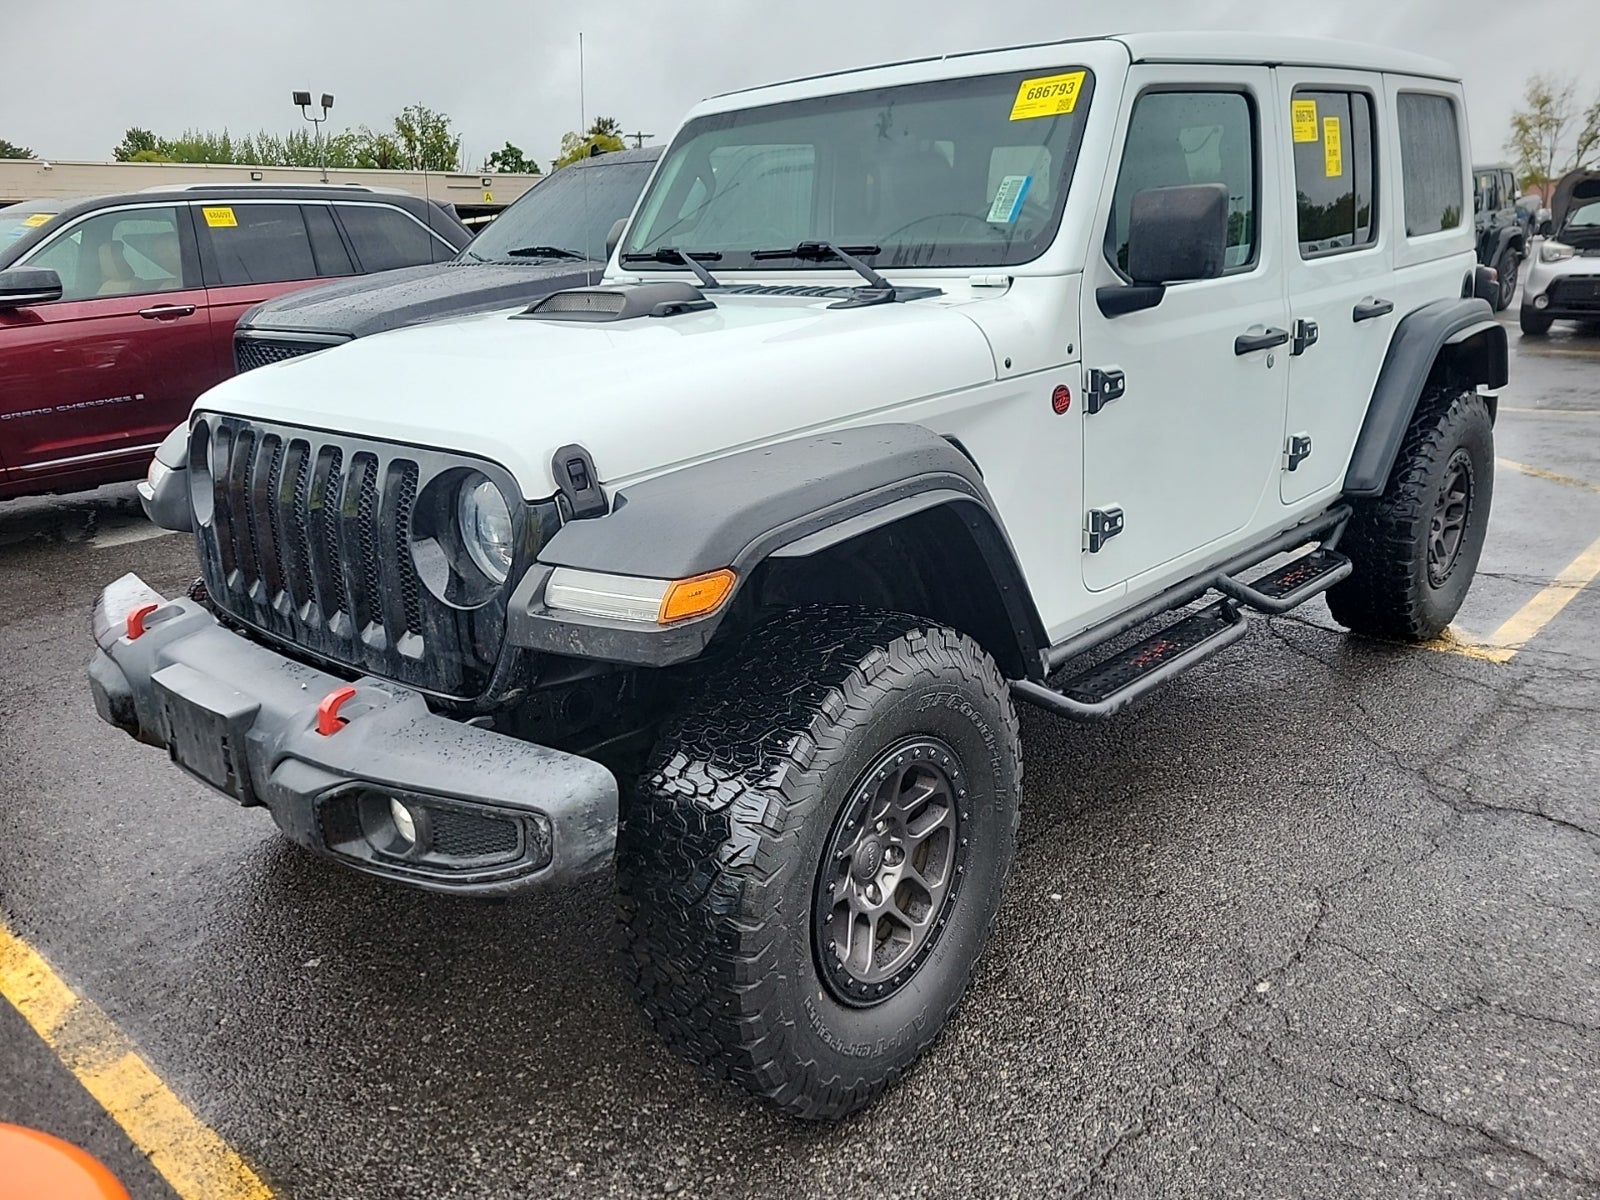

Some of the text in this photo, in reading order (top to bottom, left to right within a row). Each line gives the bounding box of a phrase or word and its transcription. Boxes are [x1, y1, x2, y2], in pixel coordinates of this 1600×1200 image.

[1027, 82, 1075, 101] 686793
[485, 193, 492, 201] A
[1, 407, 52, 420] GRAND
[56, 395, 132, 411] CHEROKEE
